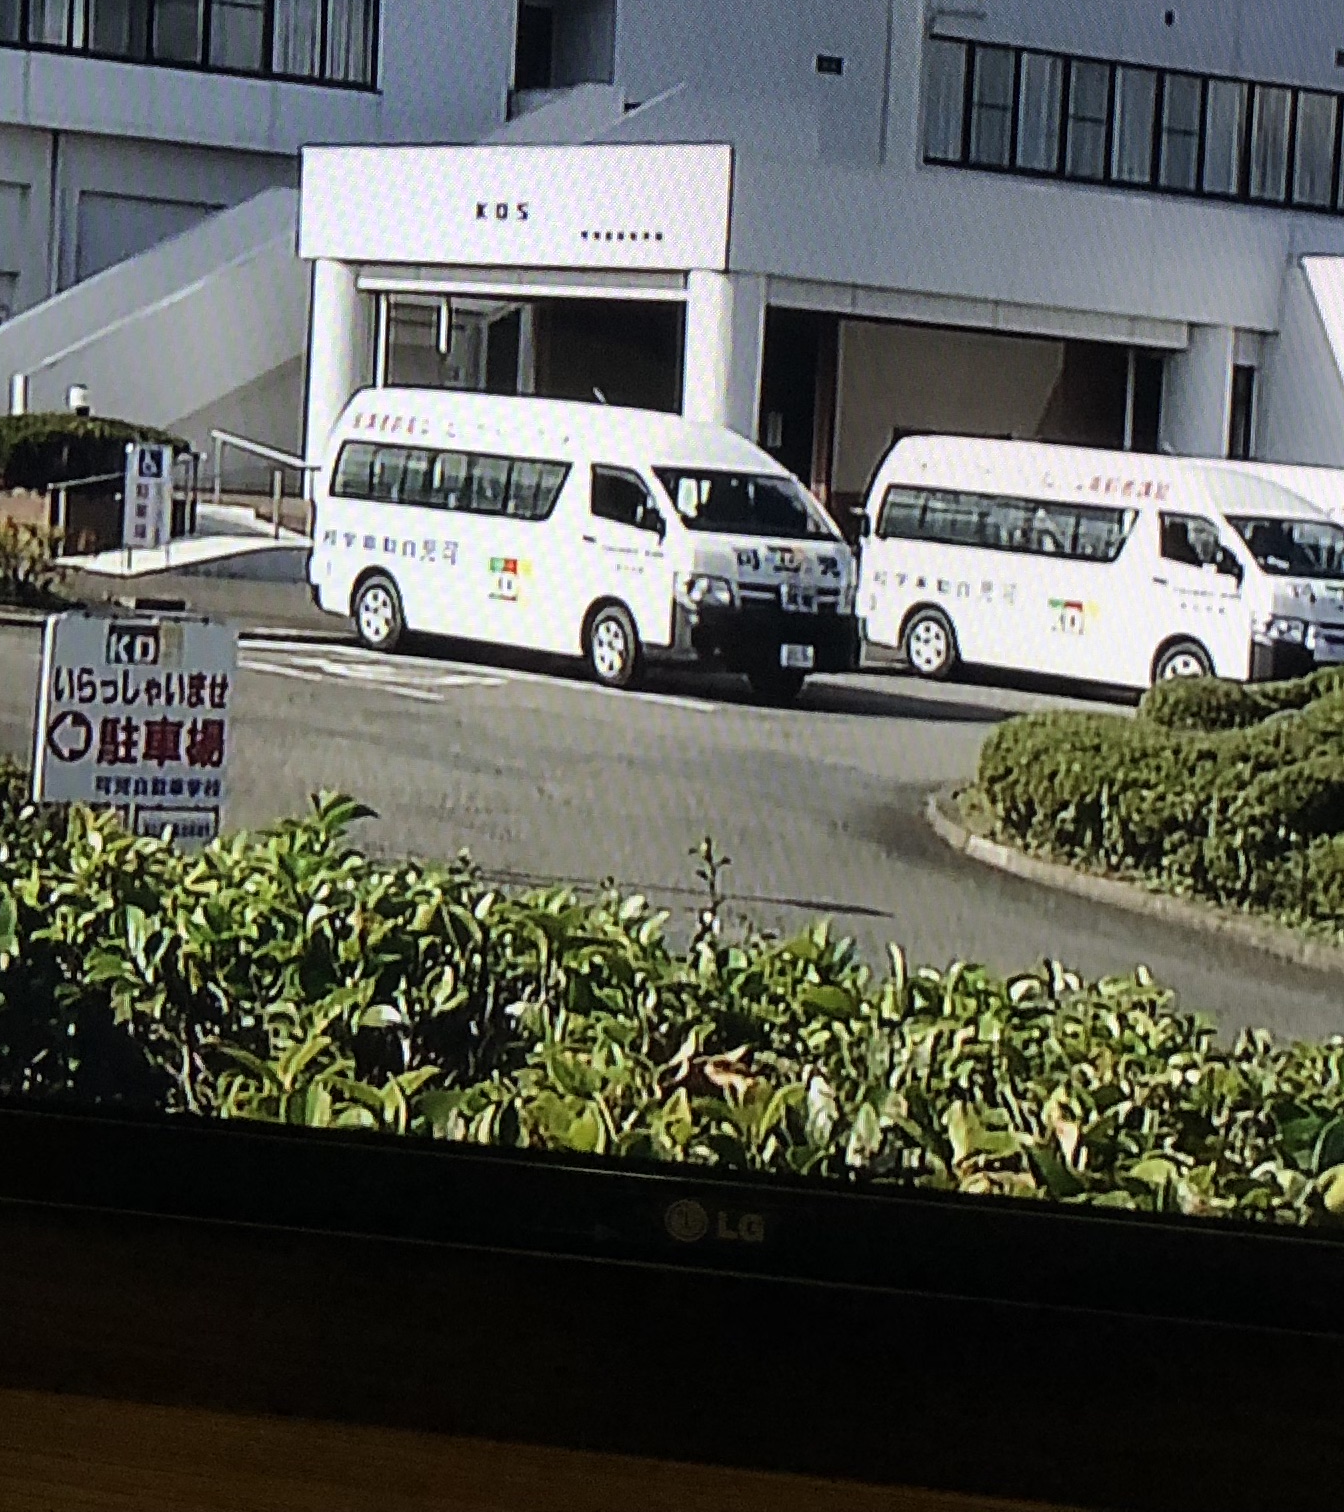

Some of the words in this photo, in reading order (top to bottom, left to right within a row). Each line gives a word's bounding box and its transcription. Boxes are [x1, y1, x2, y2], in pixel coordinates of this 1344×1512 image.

[55, 667, 228, 708] いらっしゃいませ
[718, 1210, 765, 1242] LG
